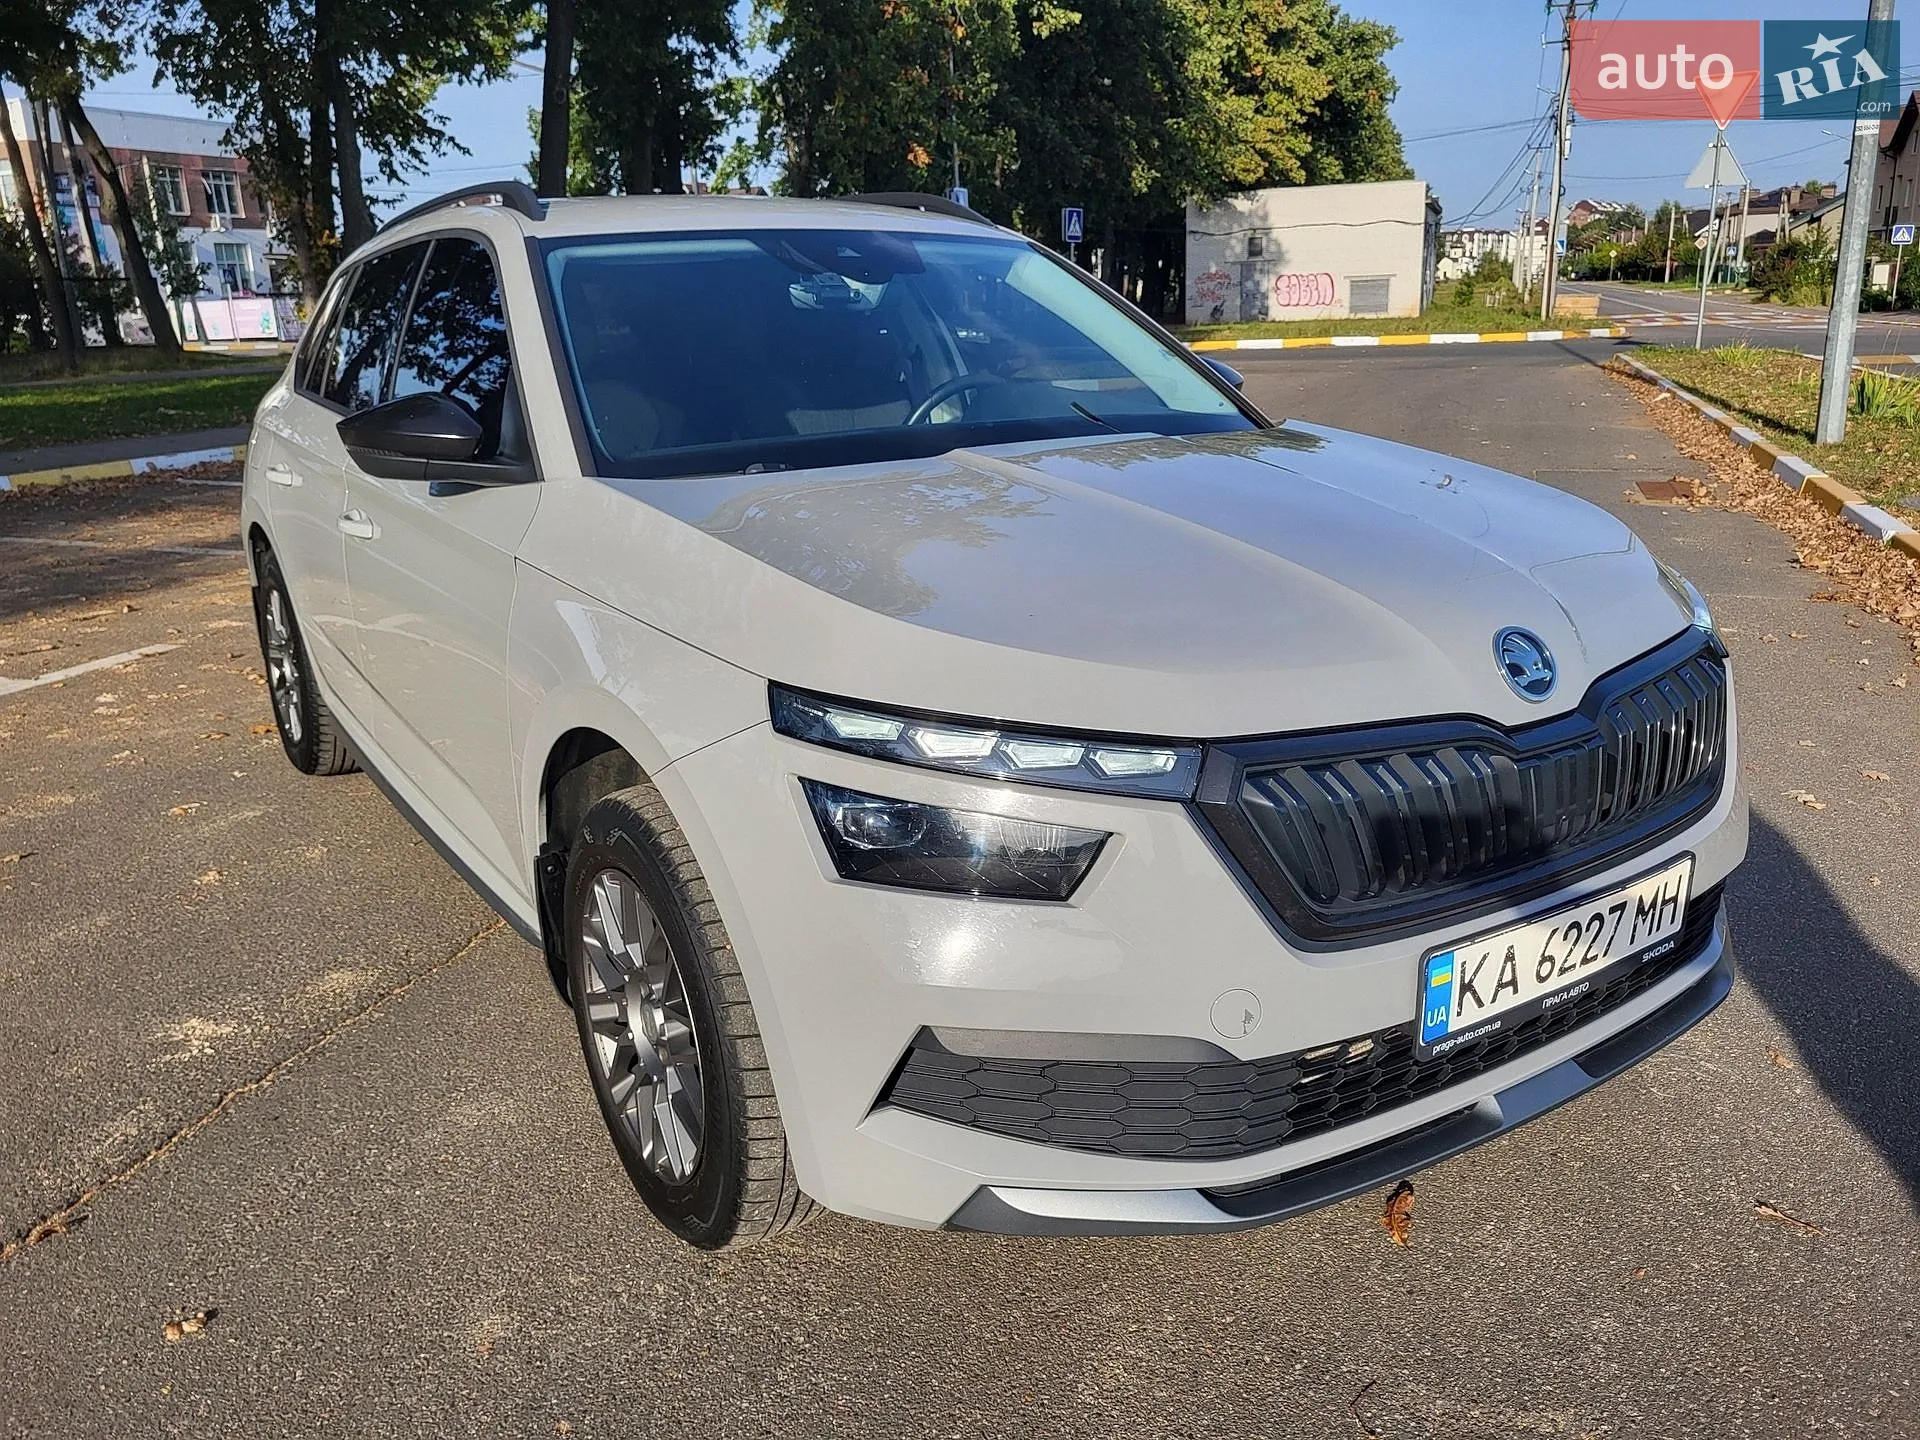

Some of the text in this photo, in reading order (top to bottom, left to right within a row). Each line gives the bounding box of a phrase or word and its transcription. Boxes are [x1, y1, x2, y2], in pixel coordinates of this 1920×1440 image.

[1456, 874, 1682, 1017] KA 6227 MH
[1641, 940, 1675, 963] SKODA
[1542, 981, 1590, 1009] ПРАГА АВТО
[1427, 1005, 1446, 1027] UA
[1432, 1020, 1502, 1056] praga-auto.com.ua
